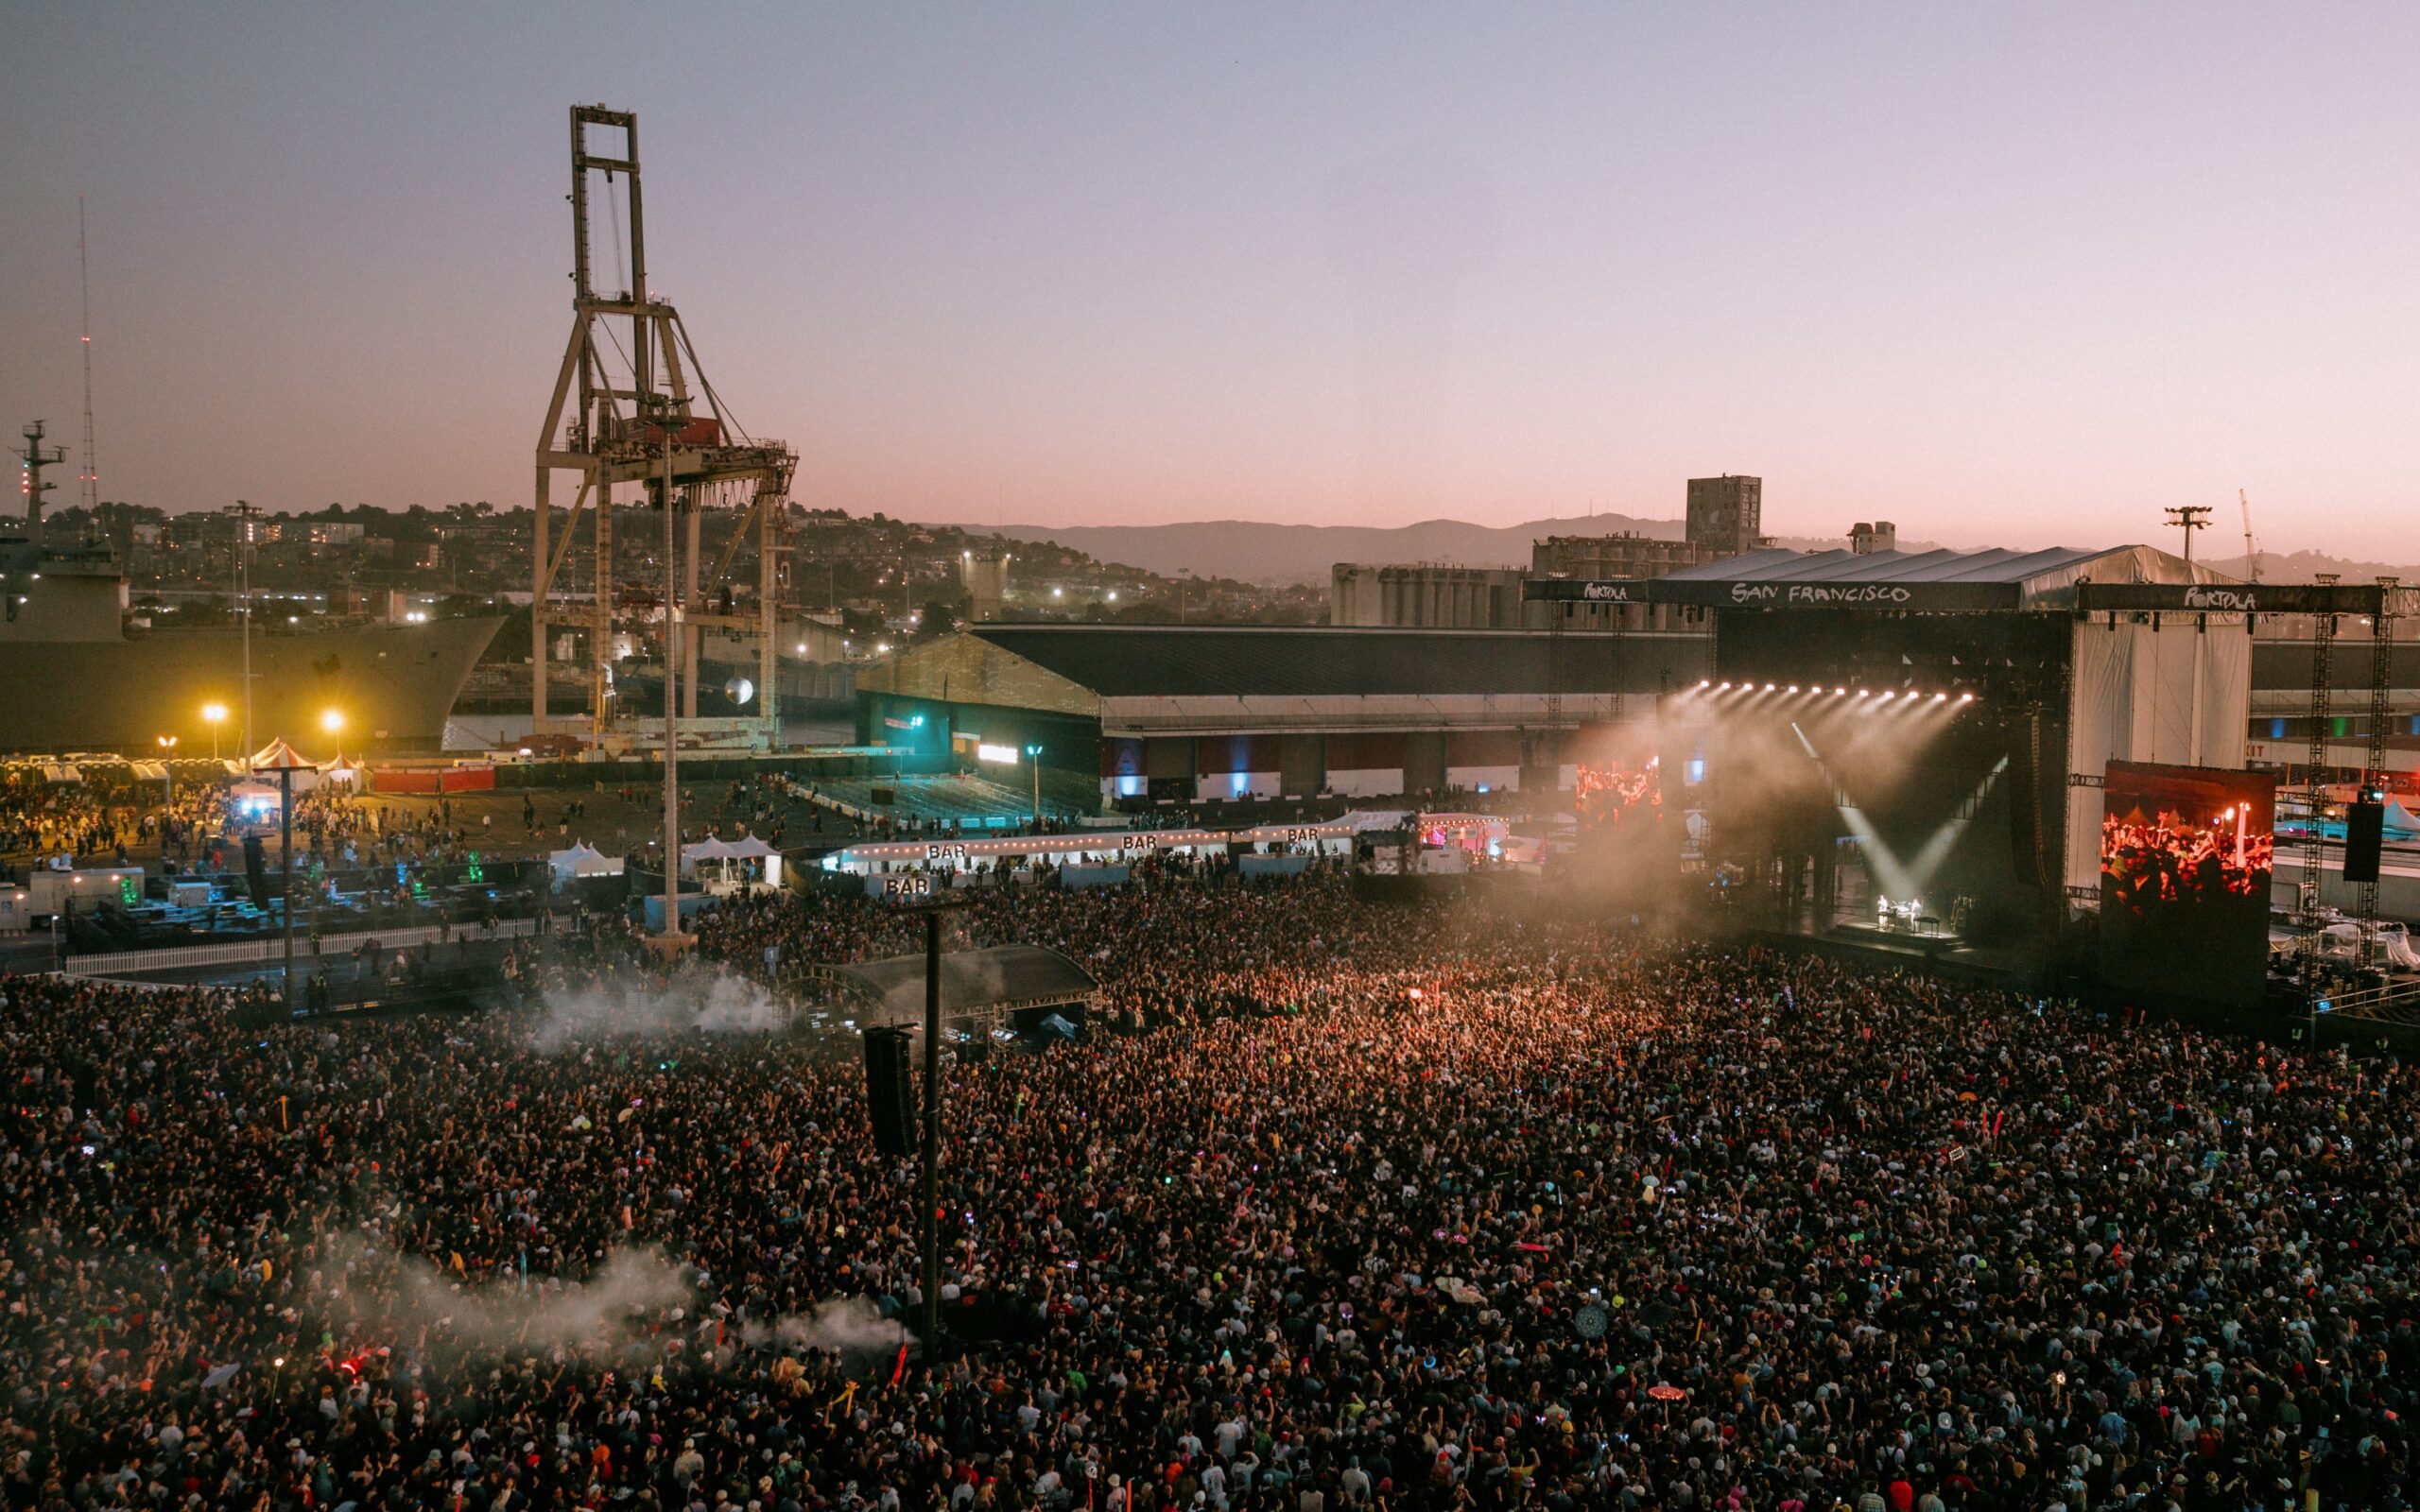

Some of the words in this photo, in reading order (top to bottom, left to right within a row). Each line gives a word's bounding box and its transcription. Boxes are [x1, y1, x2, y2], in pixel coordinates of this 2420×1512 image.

[1584, 583, 1627, 600] PORTOLA
[1732, 582, 1778, 603] SAN
[1789, 585, 1911, 603] FRANCISCO
[2185, 587, 2256, 610] PORTOLA
[1123, 836, 1157, 849] BAR
[1288, 829, 1318, 841] BAR
[929, 844, 965, 858] BAR
[886, 879, 928, 894] BAR
